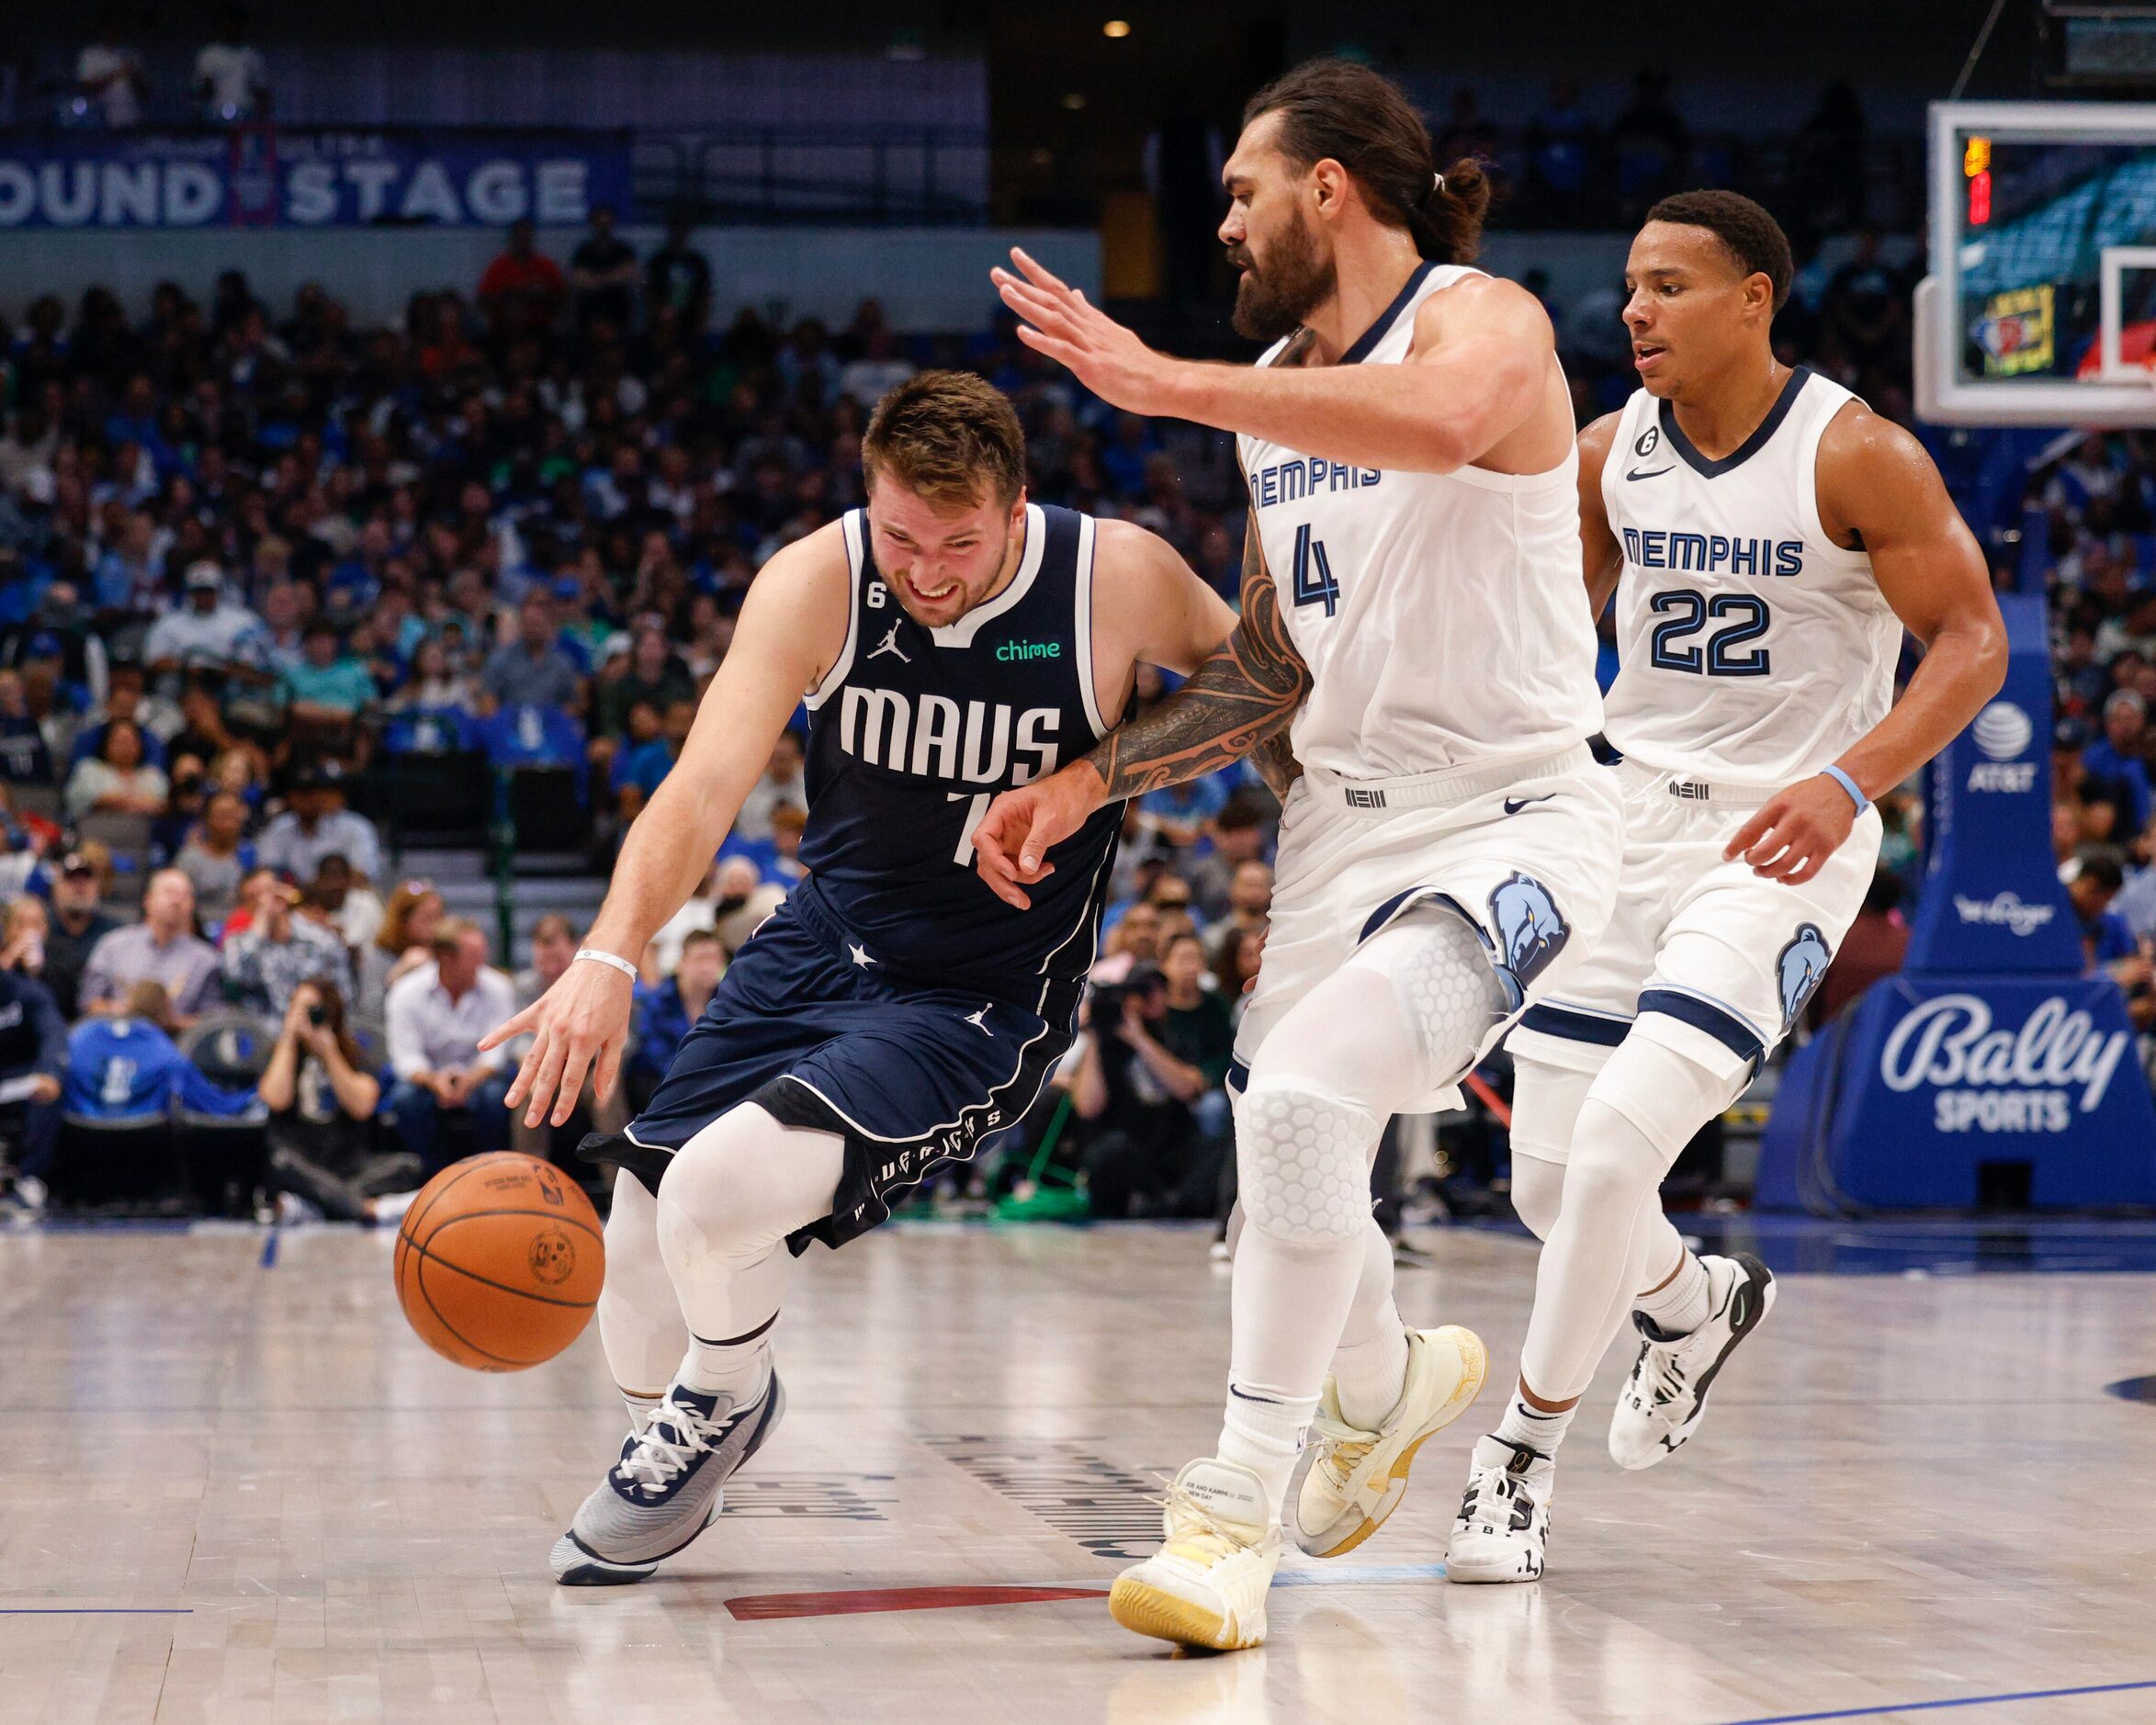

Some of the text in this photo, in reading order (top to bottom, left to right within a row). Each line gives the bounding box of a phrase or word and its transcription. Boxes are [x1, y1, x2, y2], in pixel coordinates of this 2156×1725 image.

[287, 160, 589, 226] STAGE
[1641, 430, 1656, 454] 6
[1292, 523, 1340, 618] 4
[1622, 527, 1803, 577] MEMPHIS
[866, 581, 887, 609] 6
[996, 639, 1061, 661] chime
[1650, 589, 1771, 676] 22
[840, 685, 1061, 786] MAVS
[1880, 994, 2129, 1113] Bally
[1935, 1088, 2071, 1133] SPORTS
